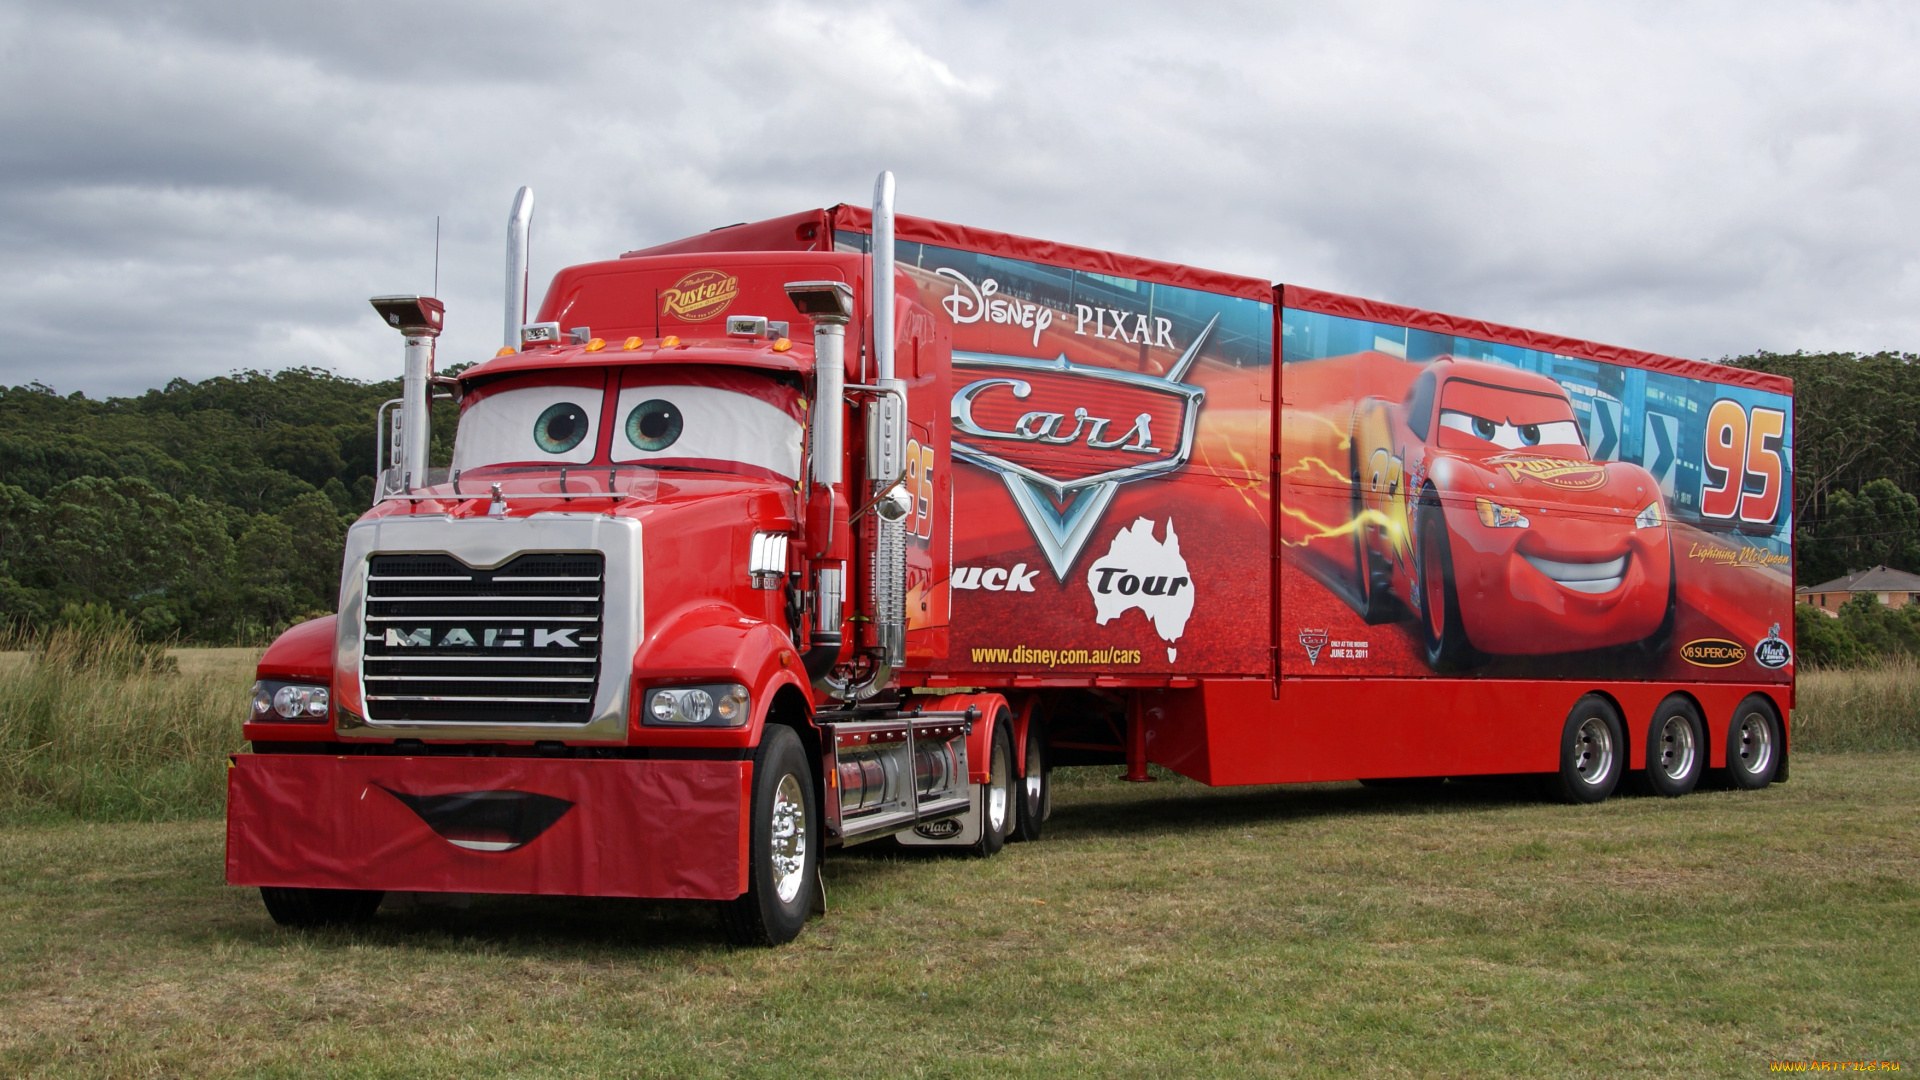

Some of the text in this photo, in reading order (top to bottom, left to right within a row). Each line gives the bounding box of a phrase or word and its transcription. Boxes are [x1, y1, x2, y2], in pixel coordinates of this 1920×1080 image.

[1075, 304, 1175, 349] PIXAR
[951, 378, 1162, 454] Cars
[1701, 398, 1786, 524] 95
[906, 438, 935, 542] 95
[1500, 507, 1520, 523] 95
[1688, 542, 1790, 565] Lightning McQueen
[951, 563, 1040, 592] uck
[1095, 567, 1188, 597] Tour
[385, 628, 580, 648] MACK
[971, 645, 1141, 668] www.disney.com.au/cars
[1330, 649, 1368, 660] JUNE 23, 2011
[1683, 646, 1744, 659] V8 SUPERCARS
[1760, 643, 1784, 660] Mack
[922, 821, 954, 833] Mack
